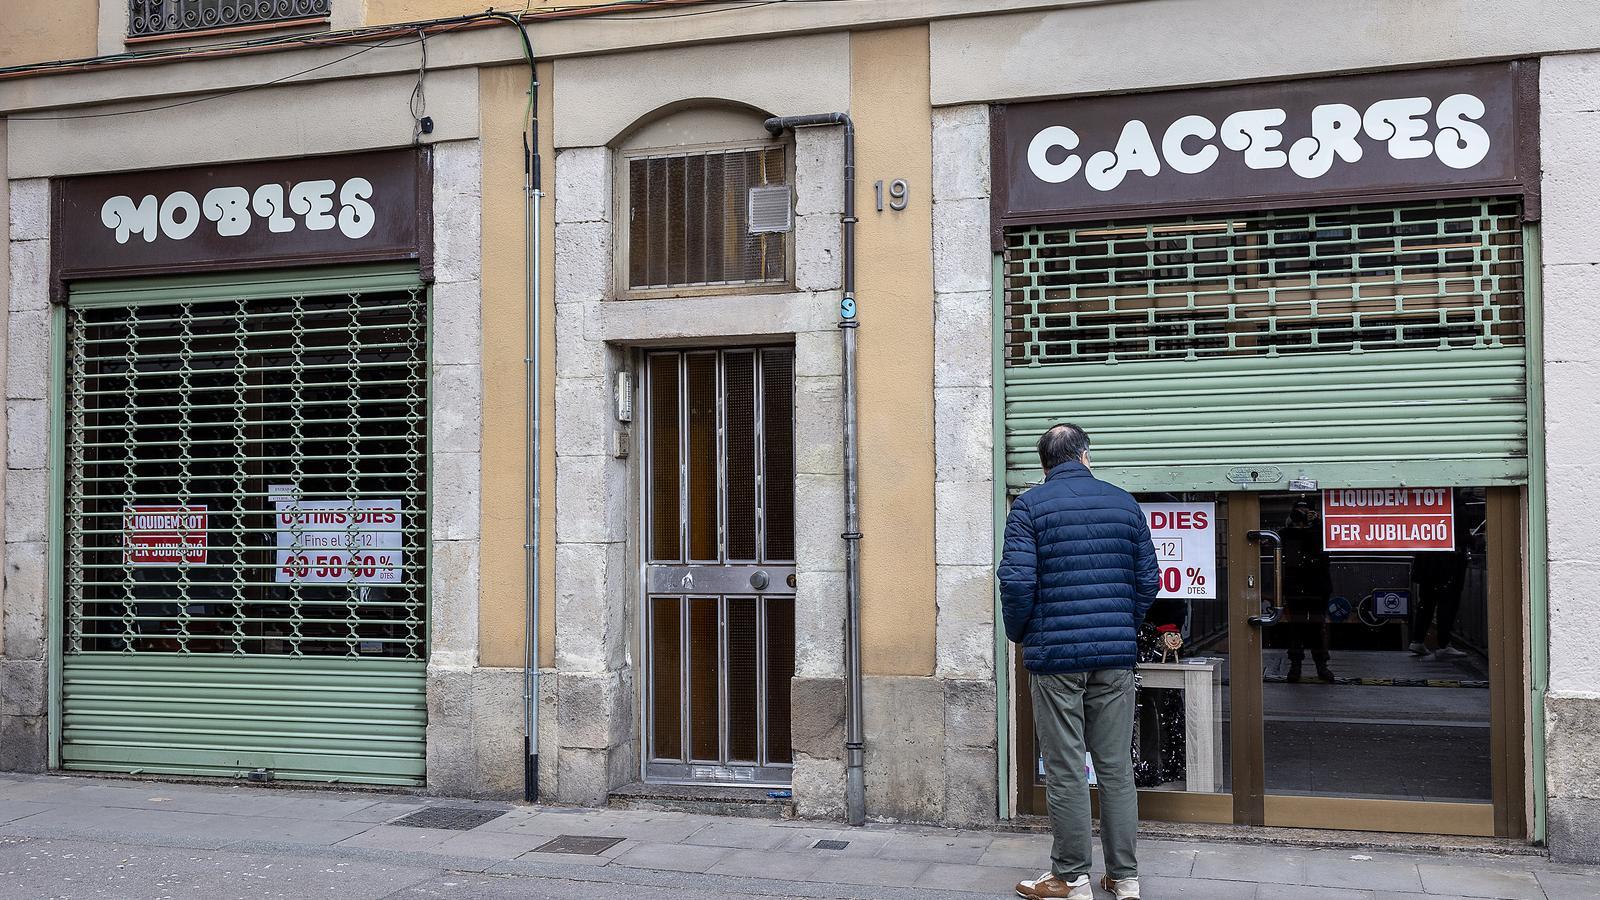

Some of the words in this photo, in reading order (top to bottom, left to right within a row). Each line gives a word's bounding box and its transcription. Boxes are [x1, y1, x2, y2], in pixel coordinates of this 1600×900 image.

[1027, 93, 1490, 191] CACERES
[873, 178, 909, 212] 19
[100, 177, 376, 244] MOBLES
[1329, 488, 1409, 508] LIQUIDEM
[1412, 488, 1446, 506] TOT
[354, 507, 396, 525] DIES
[1150, 511, 1209, 530] DIES
[1330, 524, 1362, 542] PER
[1365, 519, 1448, 542] JUBILACIÓ
[304, 534, 328, 547] Fins
[330, 534, 341, 547] el
[344, 534, 372, 547] 3-12
[1186, 567, 1206, 586] %
[1187, 586, 1208, 595] DTES.
